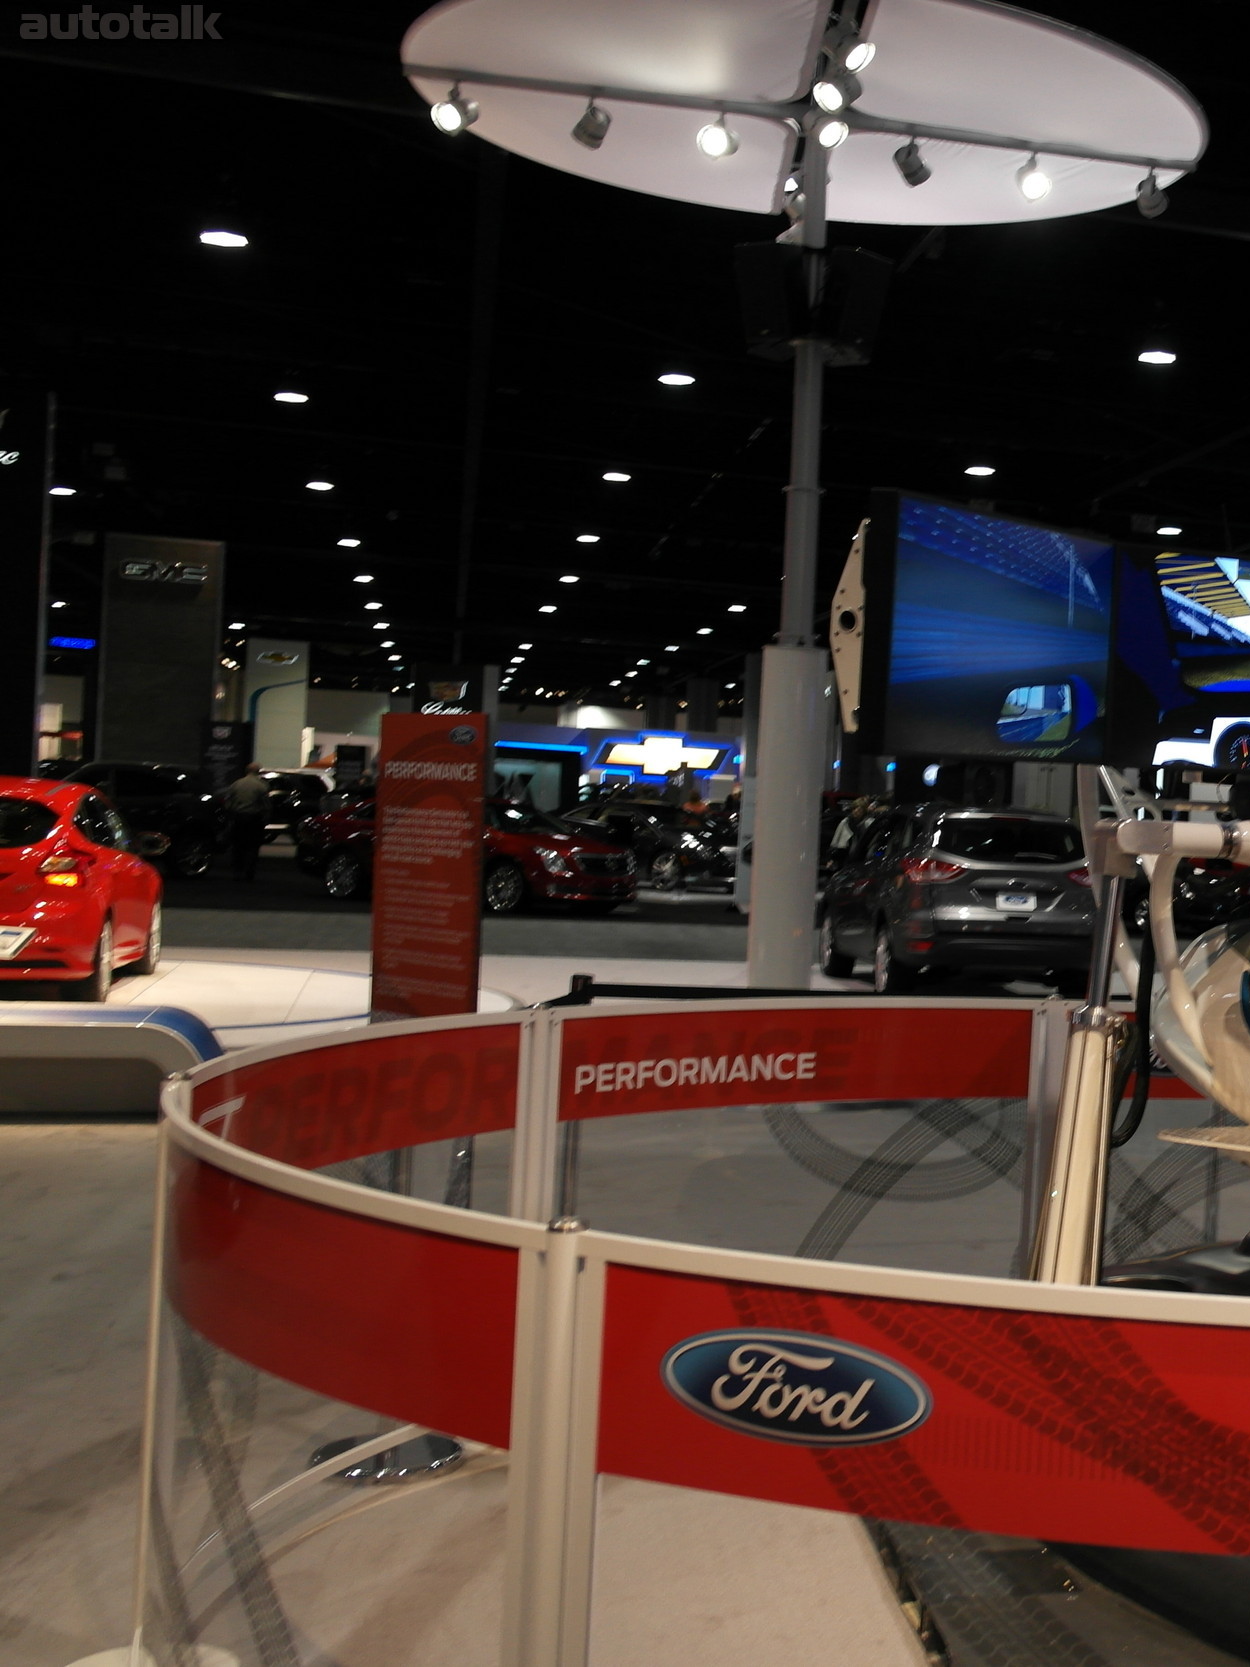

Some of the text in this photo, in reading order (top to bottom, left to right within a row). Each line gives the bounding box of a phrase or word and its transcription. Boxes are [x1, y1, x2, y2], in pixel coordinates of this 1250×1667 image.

[384, 760, 478, 782] PERFORMANCE
[574, 1051, 817, 1095] PERFORMANCE
[711, 1343, 876, 1430] Ford
